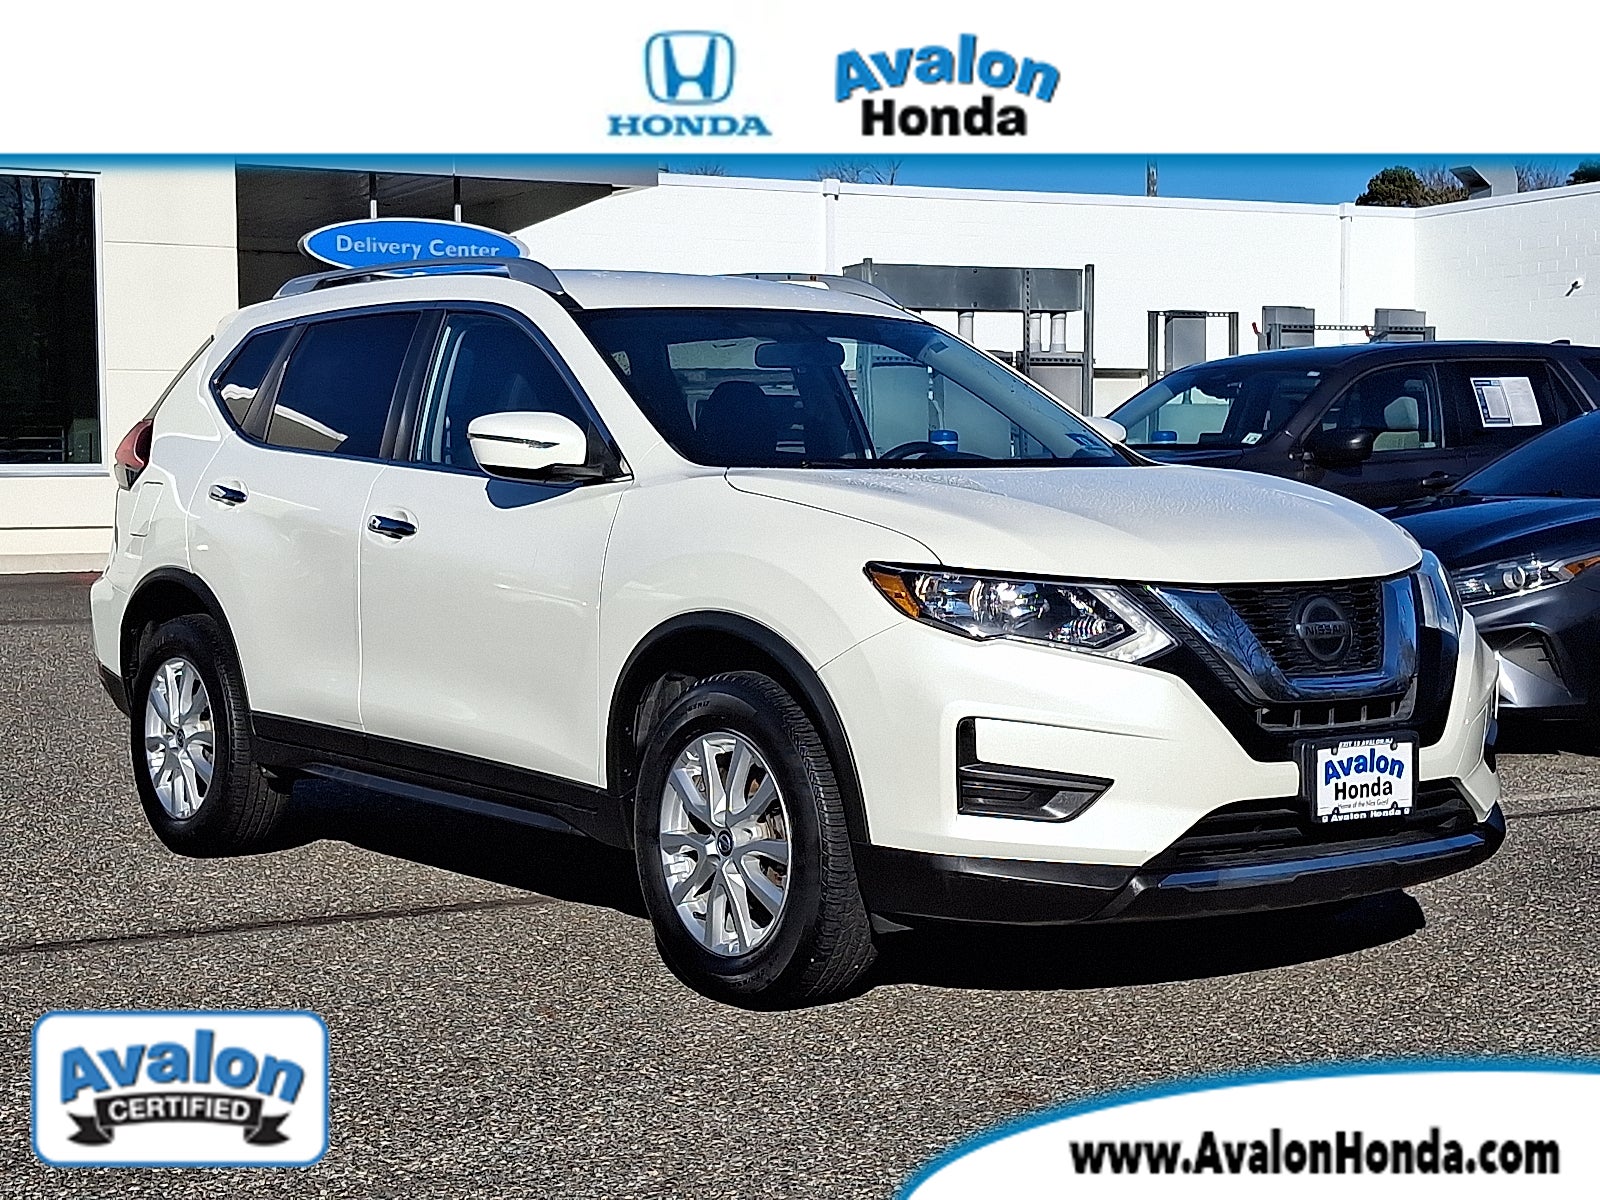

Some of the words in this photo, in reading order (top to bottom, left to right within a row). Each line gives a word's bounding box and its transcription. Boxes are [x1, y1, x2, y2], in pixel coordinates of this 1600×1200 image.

[336, 234, 421, 260] Delivery
[429, 239, 499, 257] Center
[1324, 748, 1405, 786] Avalon
[1334, 776, 1393, 800] Honda
[1330, 812, 1367, 823] Avalon
[1370, 808, 1402, 818] Honda
